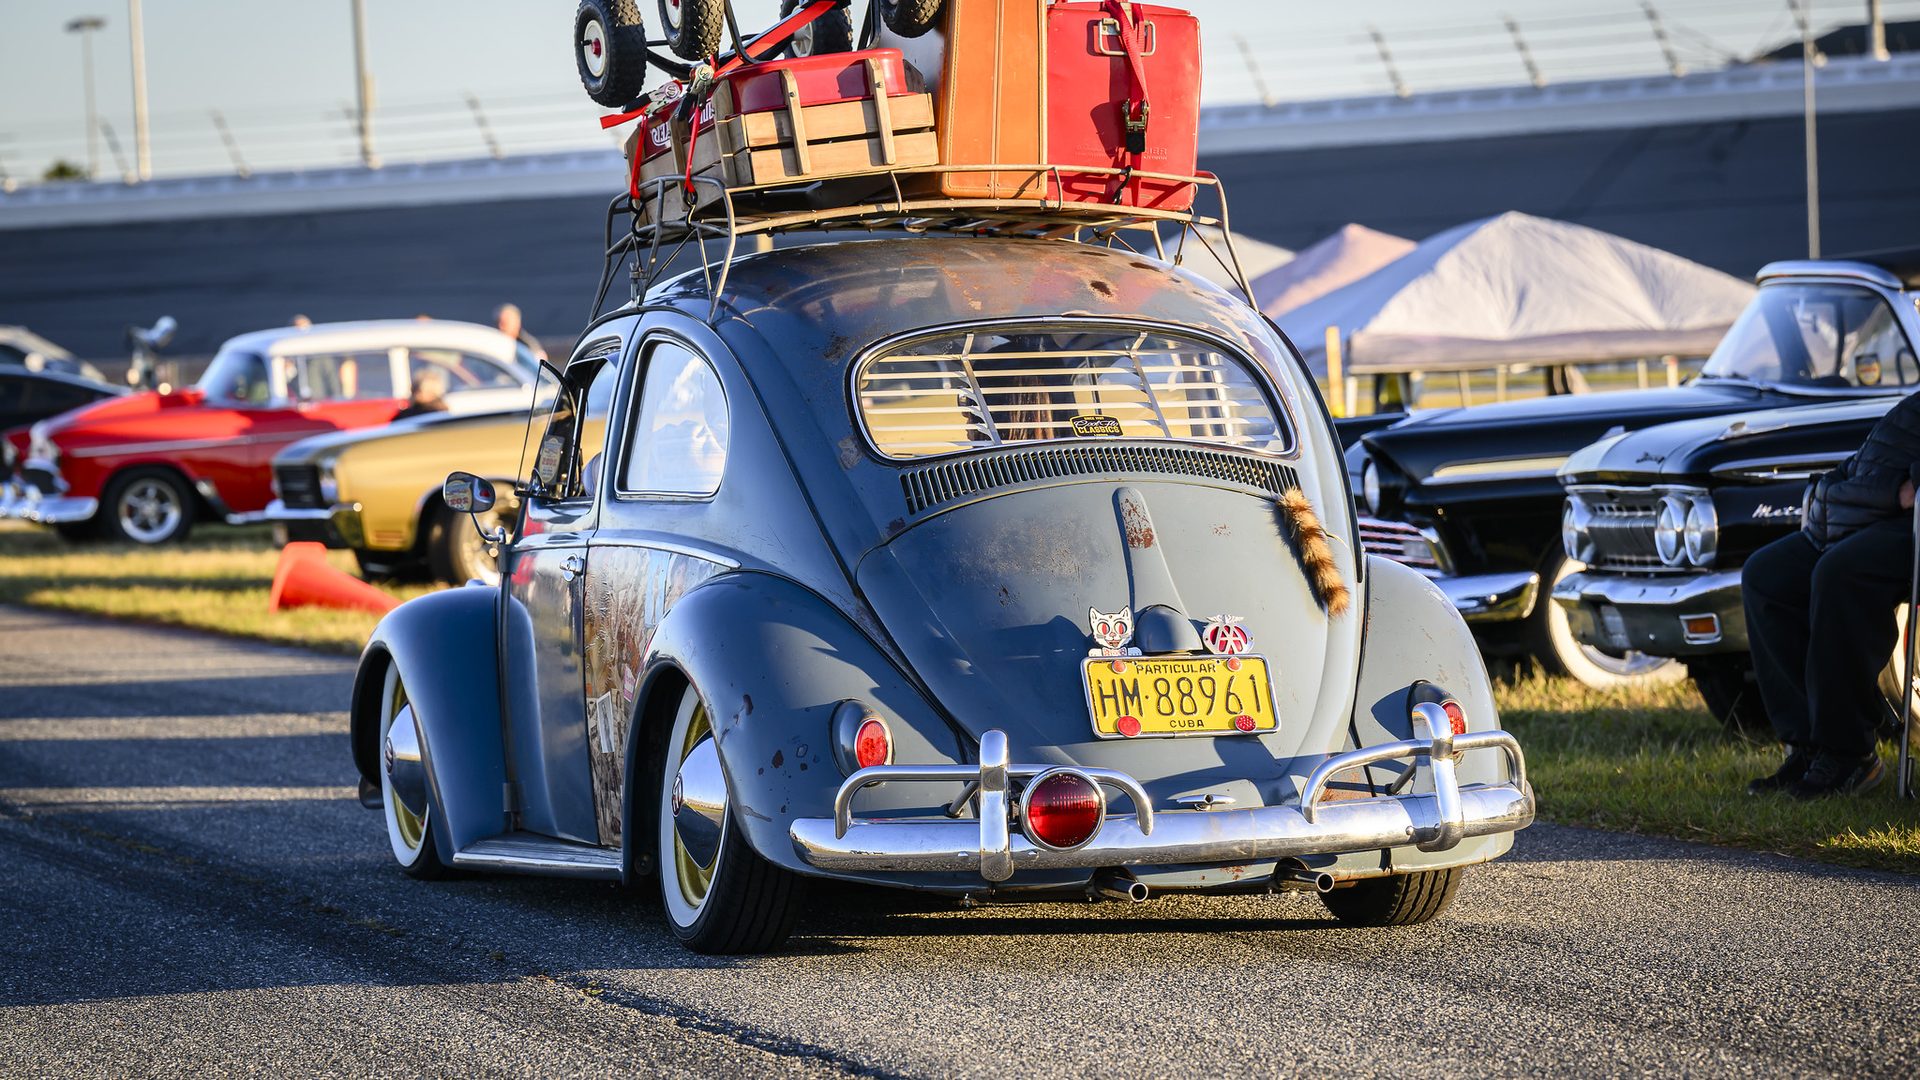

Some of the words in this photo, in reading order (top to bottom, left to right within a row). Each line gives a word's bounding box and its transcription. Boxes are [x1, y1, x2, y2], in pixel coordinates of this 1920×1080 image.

[1078, 426, 1120, 434] CLASSICS
[1752, 503, 1803, 518] Mete
[1136, 663, 1216, 674] PARTICULAR
[1169, 719, 1205, 728] CUBA
